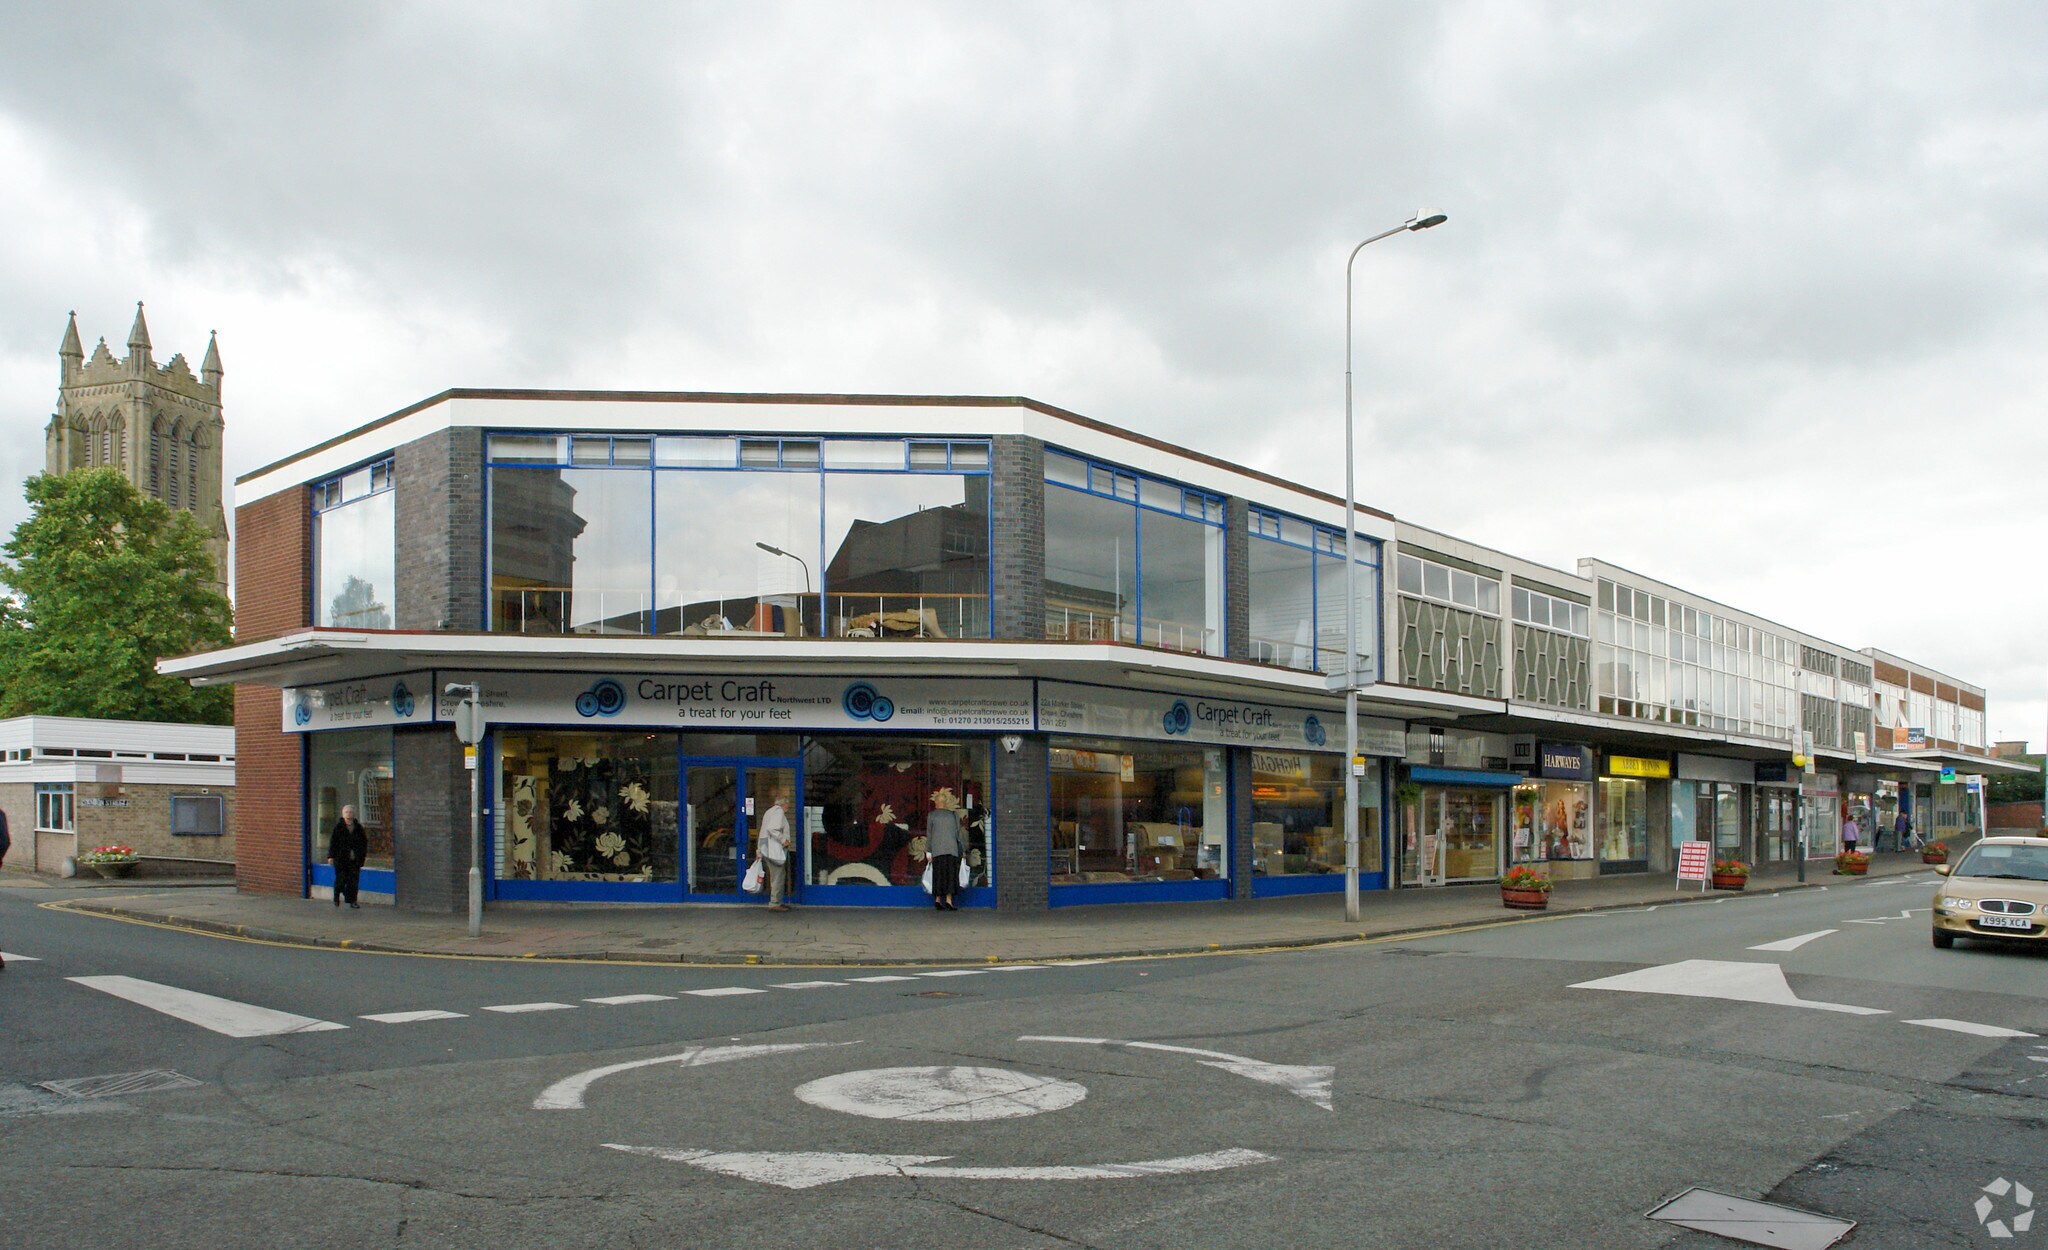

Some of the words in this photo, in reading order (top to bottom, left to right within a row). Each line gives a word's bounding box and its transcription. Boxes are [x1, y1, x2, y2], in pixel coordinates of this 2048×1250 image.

[346, 683, 367, 704] Craft
[637, 679, 713, 705] Carpet
[721, 680, 776, 702] Craft
[678, 708, 685, 718] a
[689, 707, 717, 718] treat
[720, 706, 736, 718] for
[740, 710, 766, 721] your
[769, 707, 792, 719] feet
[900, 707, 925, 715] Email:
[1196, 702, 1239, 726] Carpet
[1243, 708, 1272, 726] Craft
[973, 717, 1030, 725] 213015/255215
[1225, 728, 1241, 738] treat
[1242, 729, 1251, 739] for
[1253, 731, 1268, 741] your
[1908, 734, 1924, 744] sale
[1544, 754, 1581, 769] HARWAYES
[1983, 916, 2007, 926] X995
[2009, 919, 2027, 927] XCA
